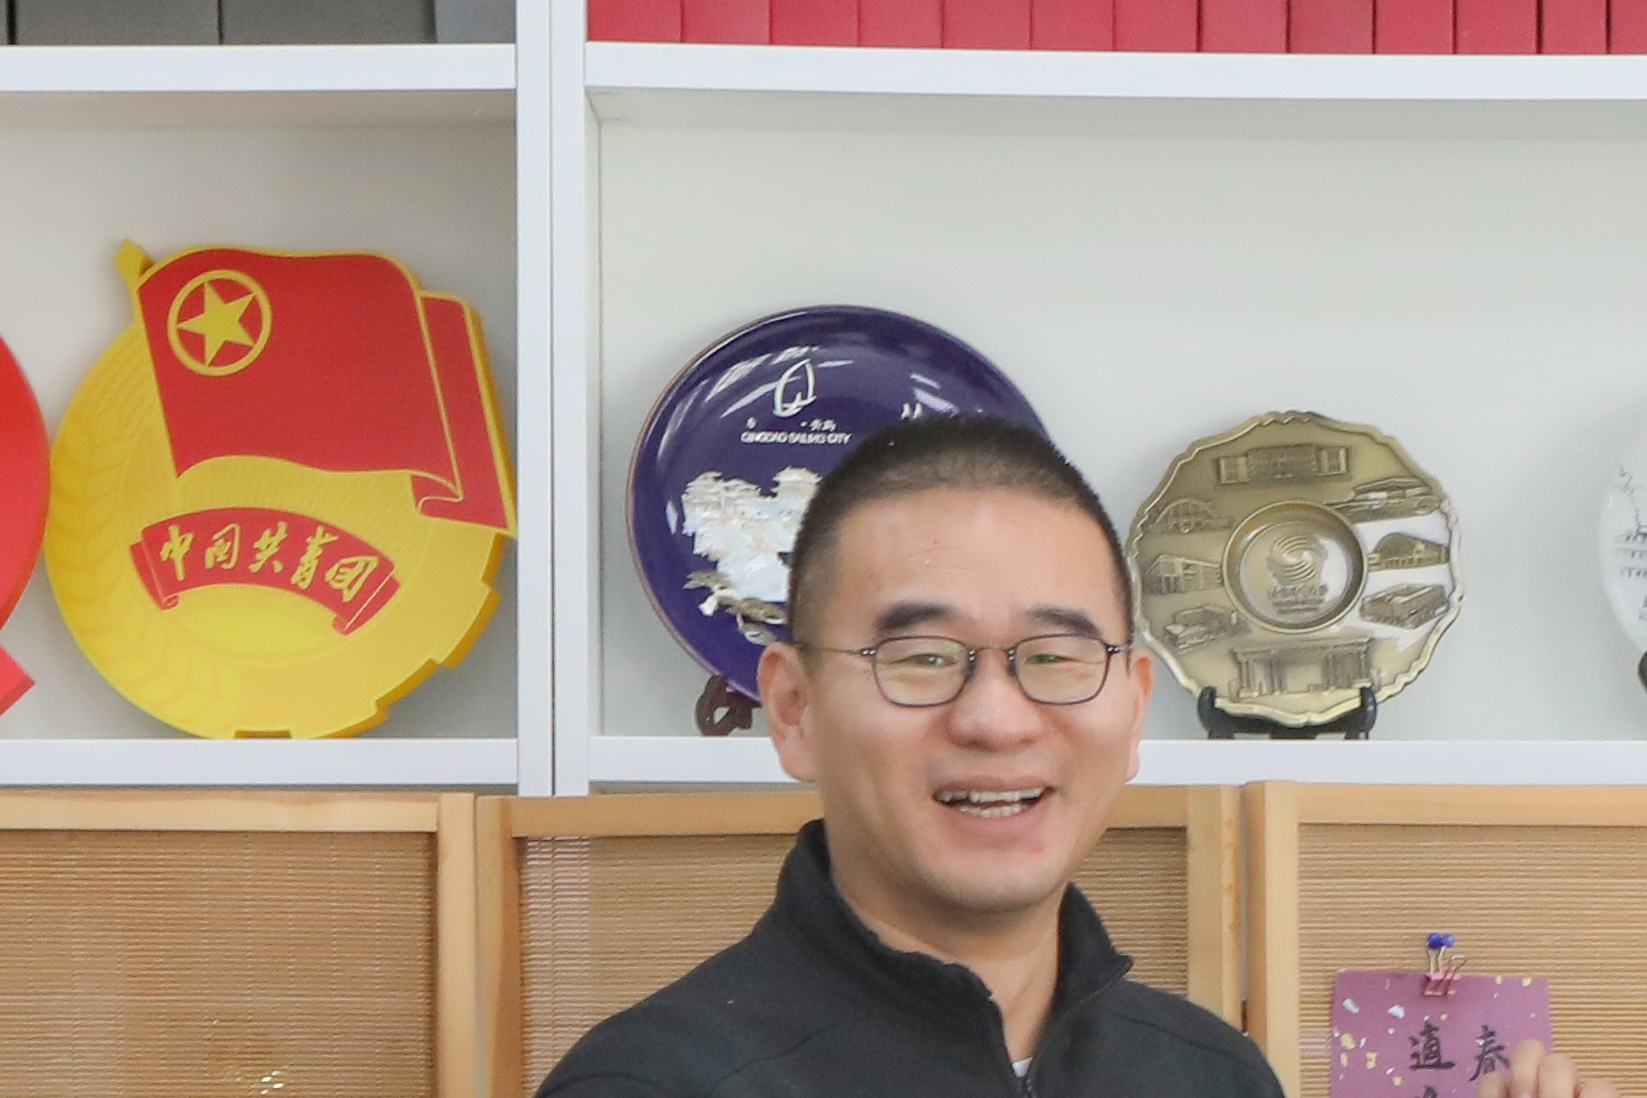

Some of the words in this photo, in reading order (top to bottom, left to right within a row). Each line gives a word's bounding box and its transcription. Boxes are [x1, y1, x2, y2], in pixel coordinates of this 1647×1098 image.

[158, 521, 380, 603] 中国共青团
